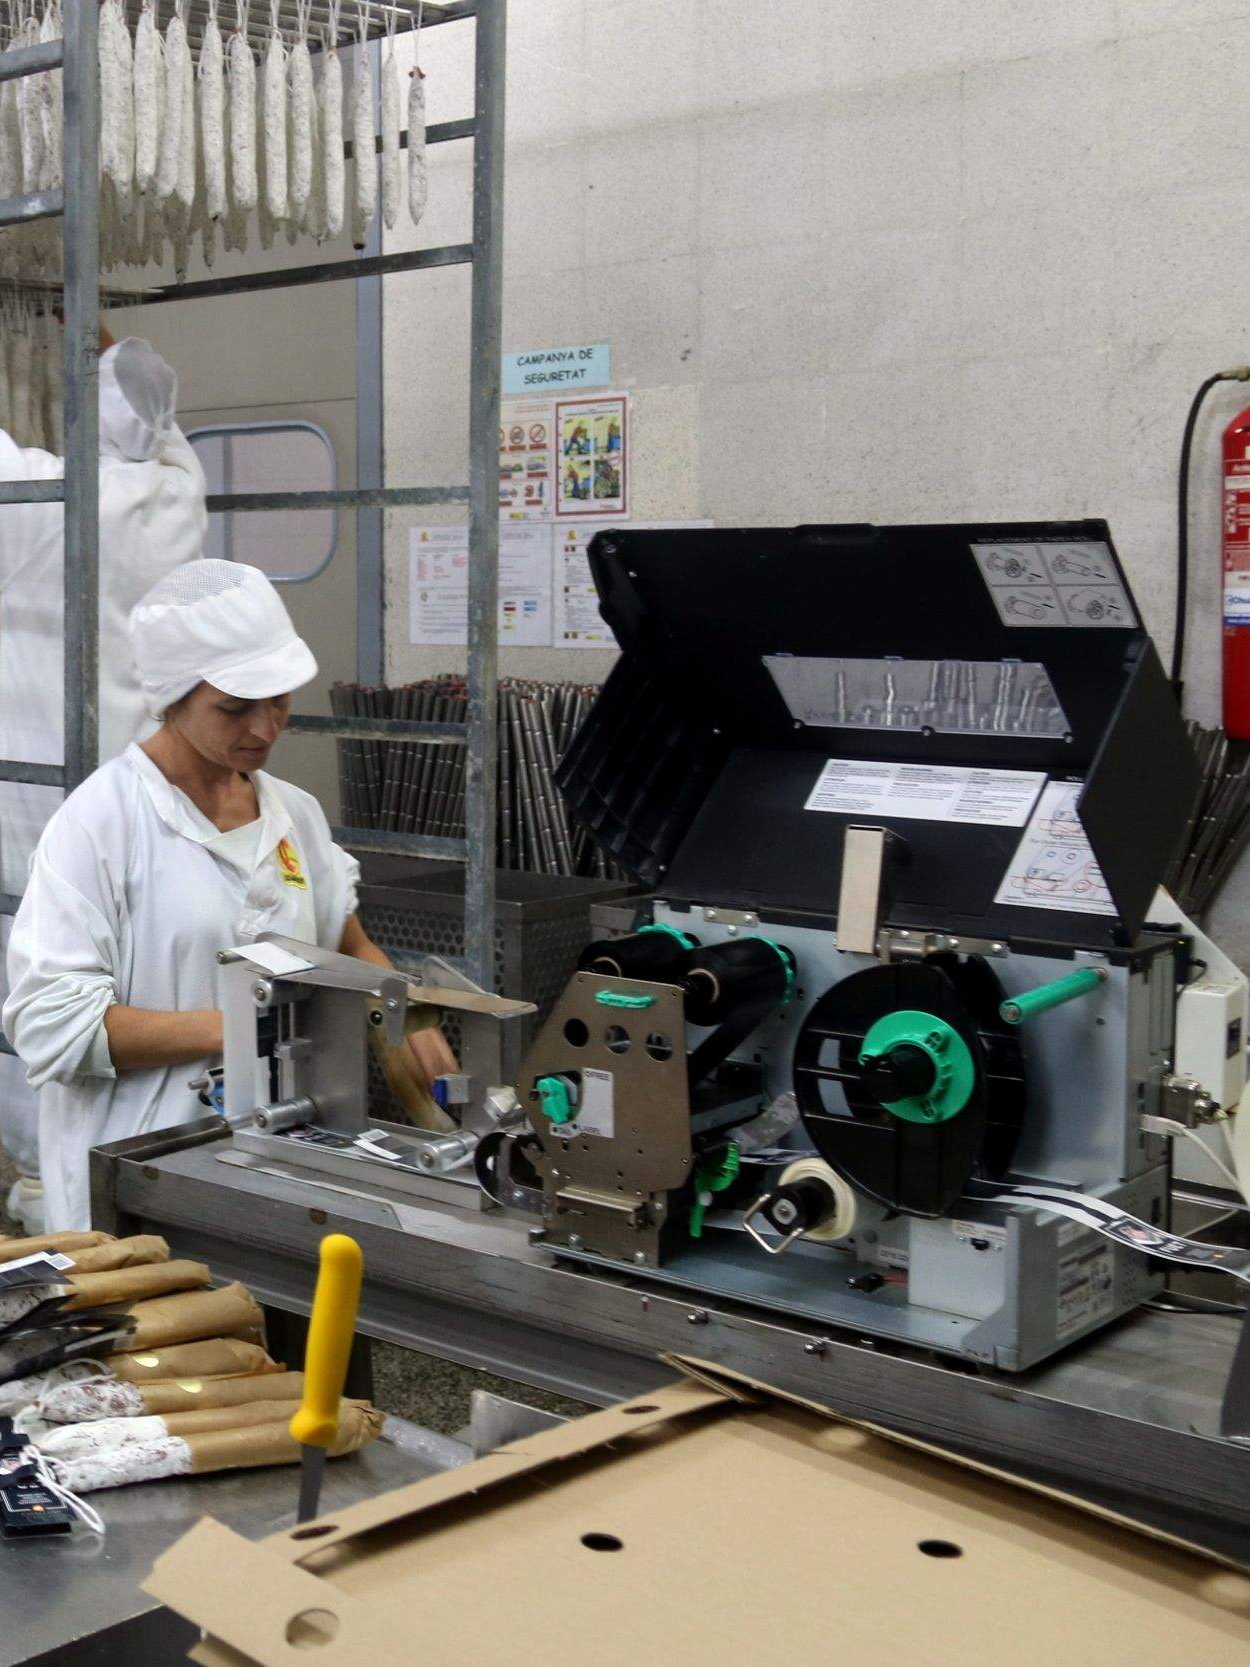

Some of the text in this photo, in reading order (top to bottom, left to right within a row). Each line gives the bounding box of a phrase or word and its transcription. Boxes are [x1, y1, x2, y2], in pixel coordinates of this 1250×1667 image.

[516, 347, 594, 367] CAMPANYA DE
[523, 368, 587, 386] SEGURETAT
